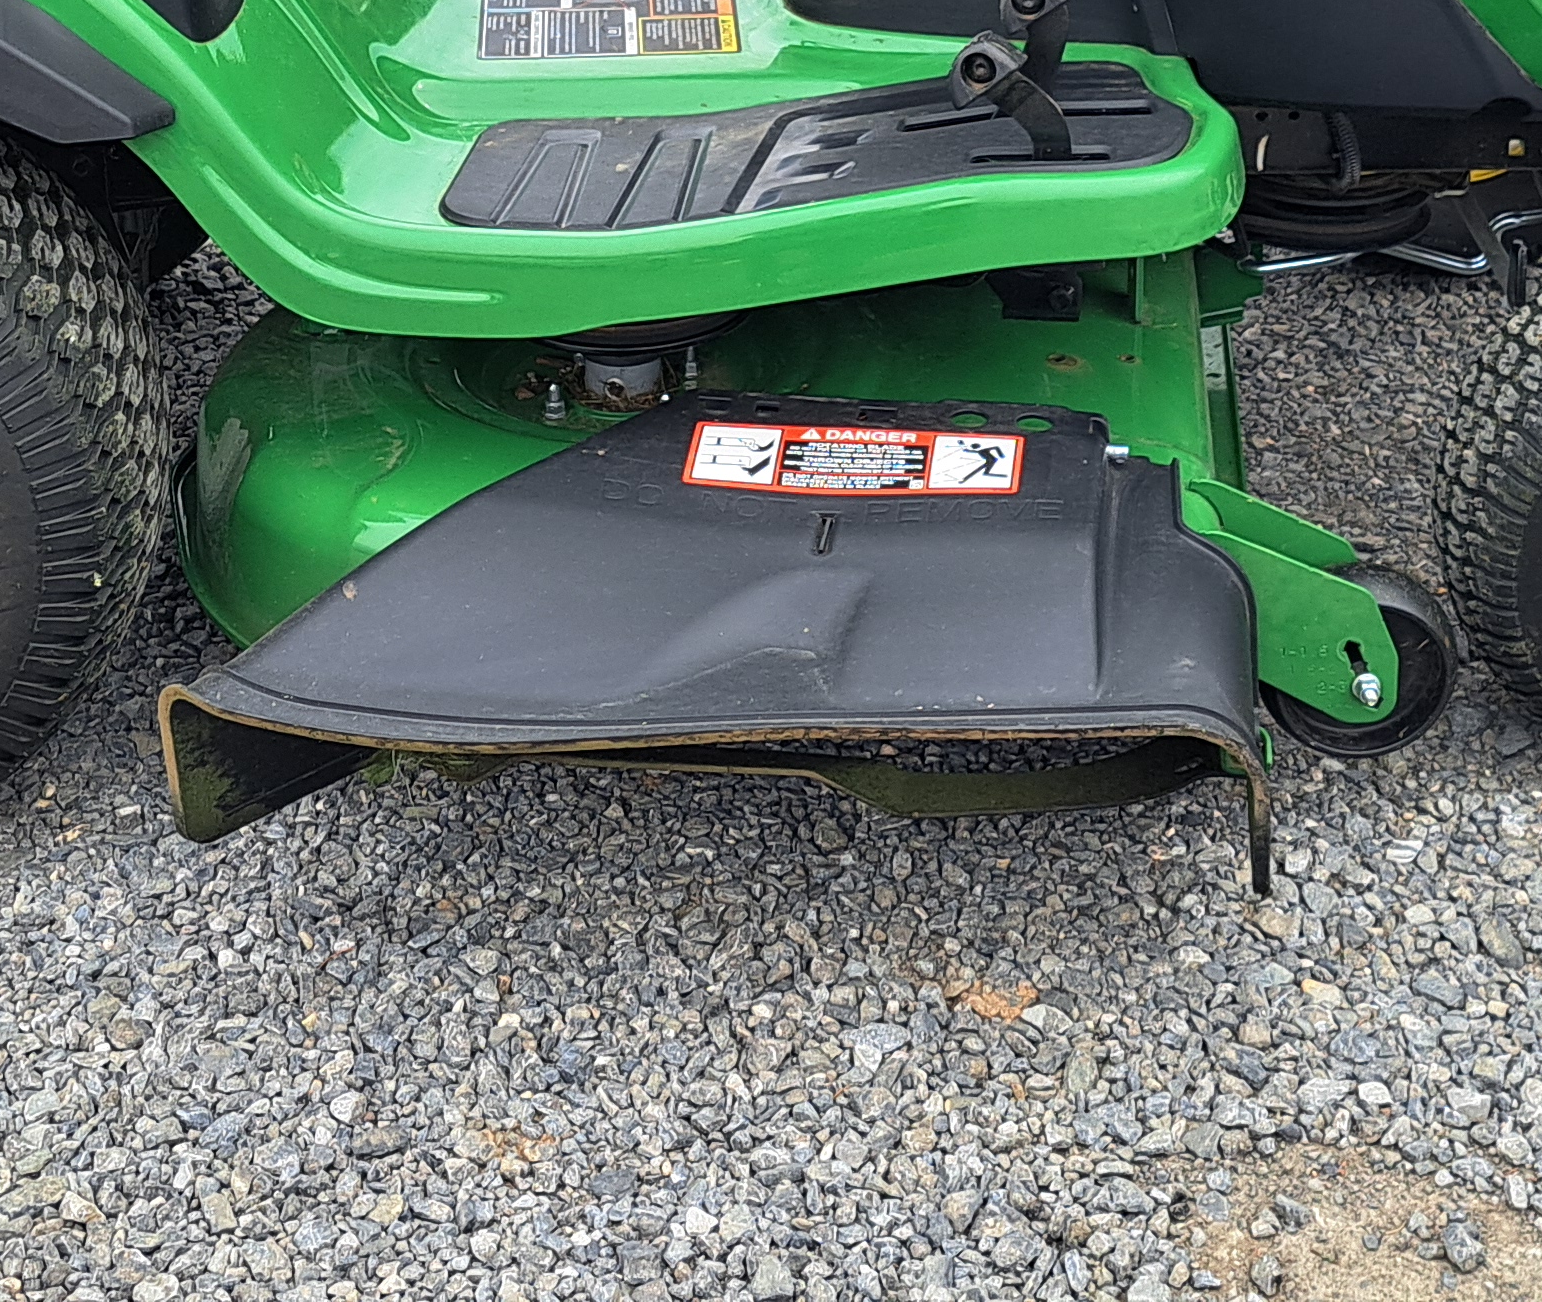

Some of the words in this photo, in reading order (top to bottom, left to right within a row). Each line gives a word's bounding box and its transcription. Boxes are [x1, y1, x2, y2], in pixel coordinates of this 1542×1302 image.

[825, 430, 917, 443] DANGER
[702, 491, 797, 518] NOT
[864, 499, 1065, 522] REMOVE
